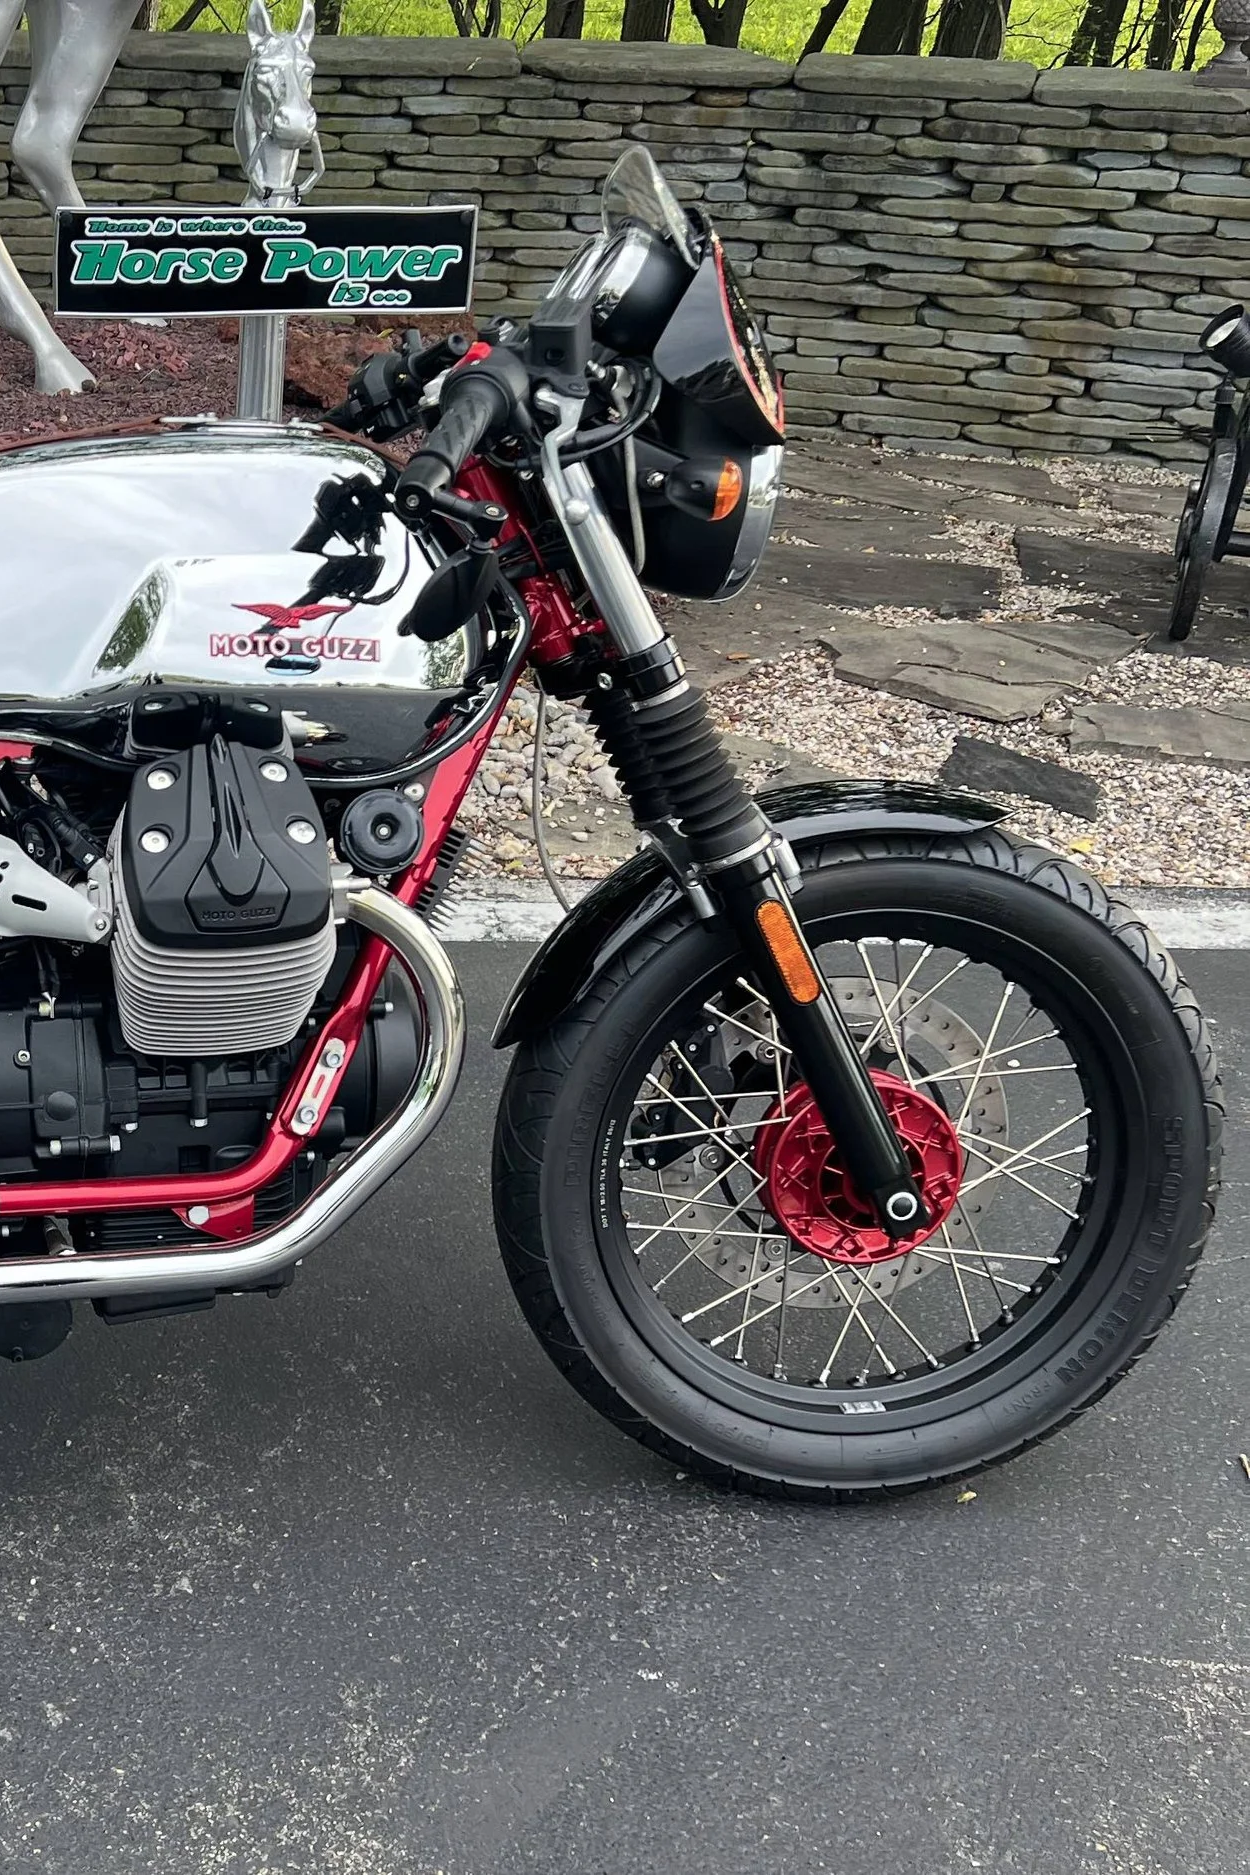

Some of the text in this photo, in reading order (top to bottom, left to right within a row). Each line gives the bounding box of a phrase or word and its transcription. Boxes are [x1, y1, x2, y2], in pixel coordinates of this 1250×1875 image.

[87, 218, 303, 233] Home is where the...
[72, 241, 459, 281] Horse Power
[331, 282, 366, 303] is
[210, 634, 381, 662] MOTO GUZZI
[202, 906, 276, 921] MOTO GUZZI
[1149, 1116, 1183, 1249] SPORT
[1054, 1265, 1158, 1383] DEMON
